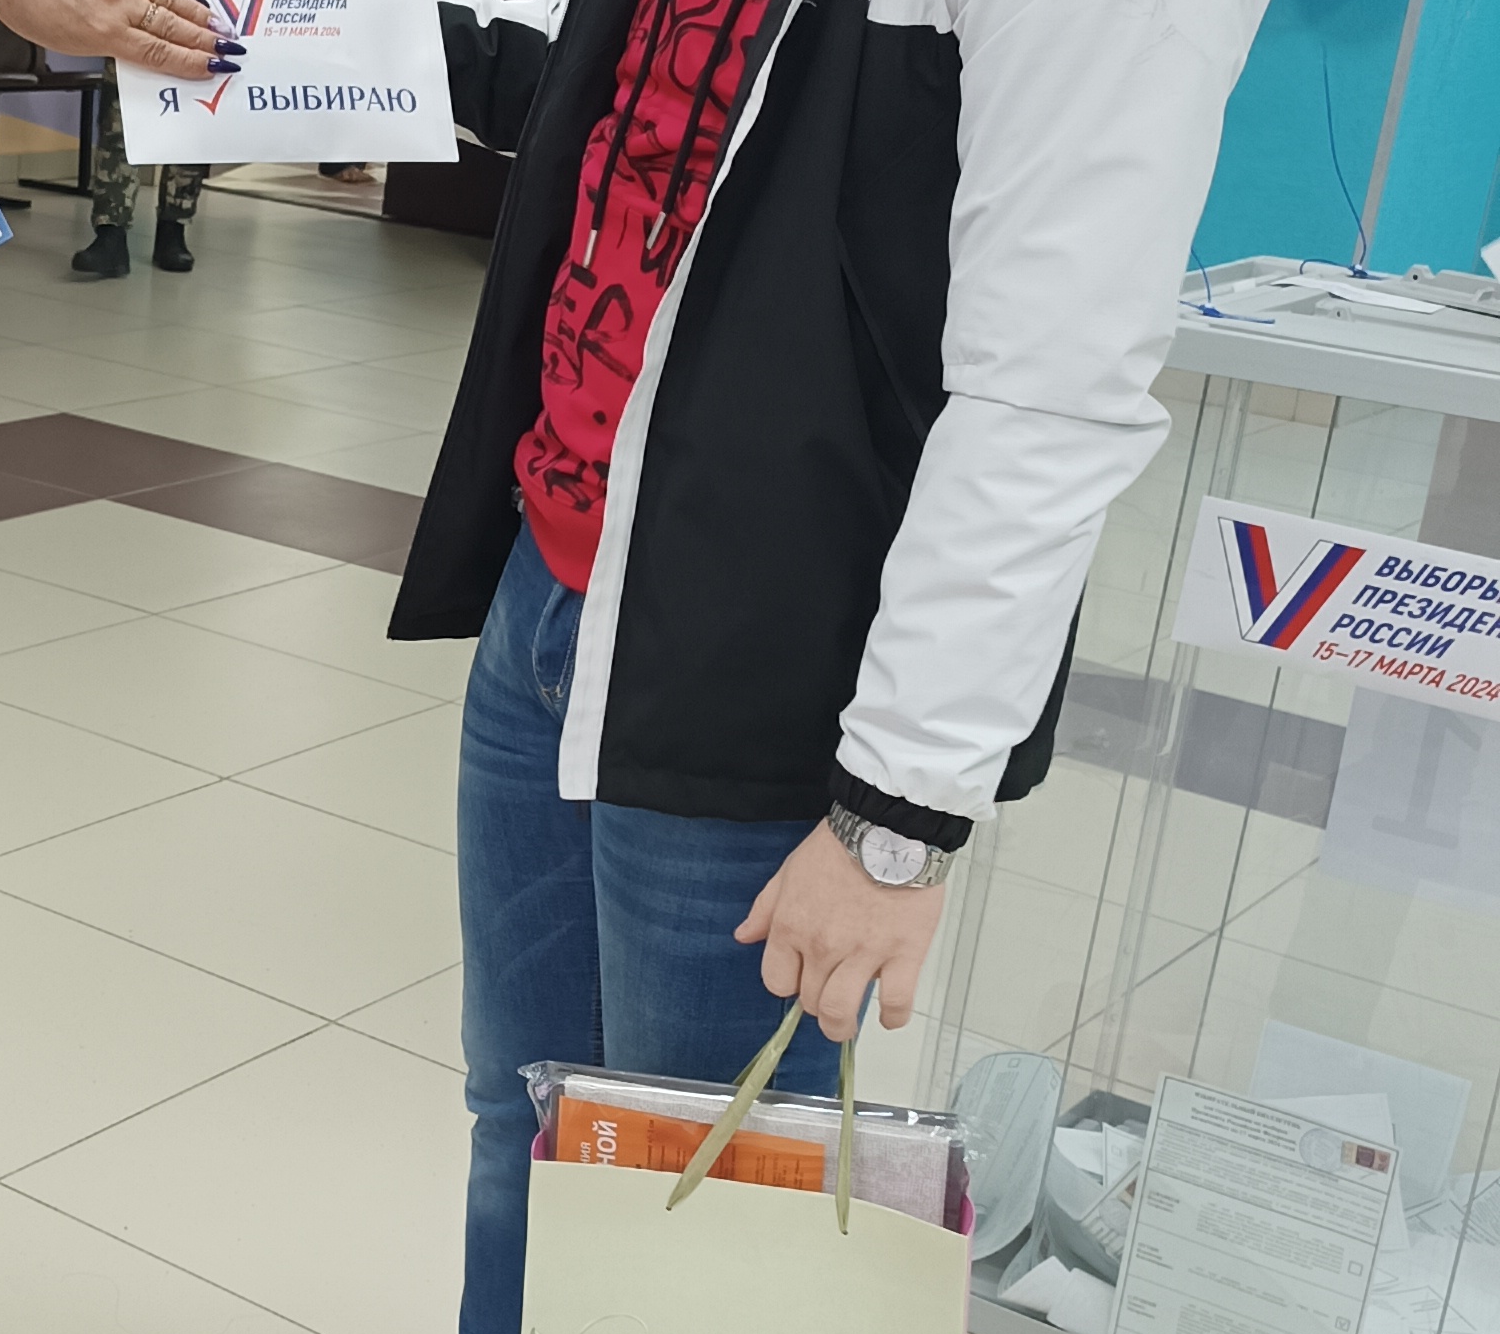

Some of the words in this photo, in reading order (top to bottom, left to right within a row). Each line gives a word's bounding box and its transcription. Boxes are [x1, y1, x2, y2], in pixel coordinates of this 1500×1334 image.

[266, 12, 316, 25] РОССИИ
[288, 27, 319, 37] МАРТА
[319, 26, 341, 37] 2024
[158, 87, 180, 117] Я
[247, 85, 417, 114] ВЫБИРАЮ
[1329, 613, 1455, 659] РОССИИ
[1370, 655, 1447, 688] МАРТА
[1446, 673, 1500, 702] 2024
